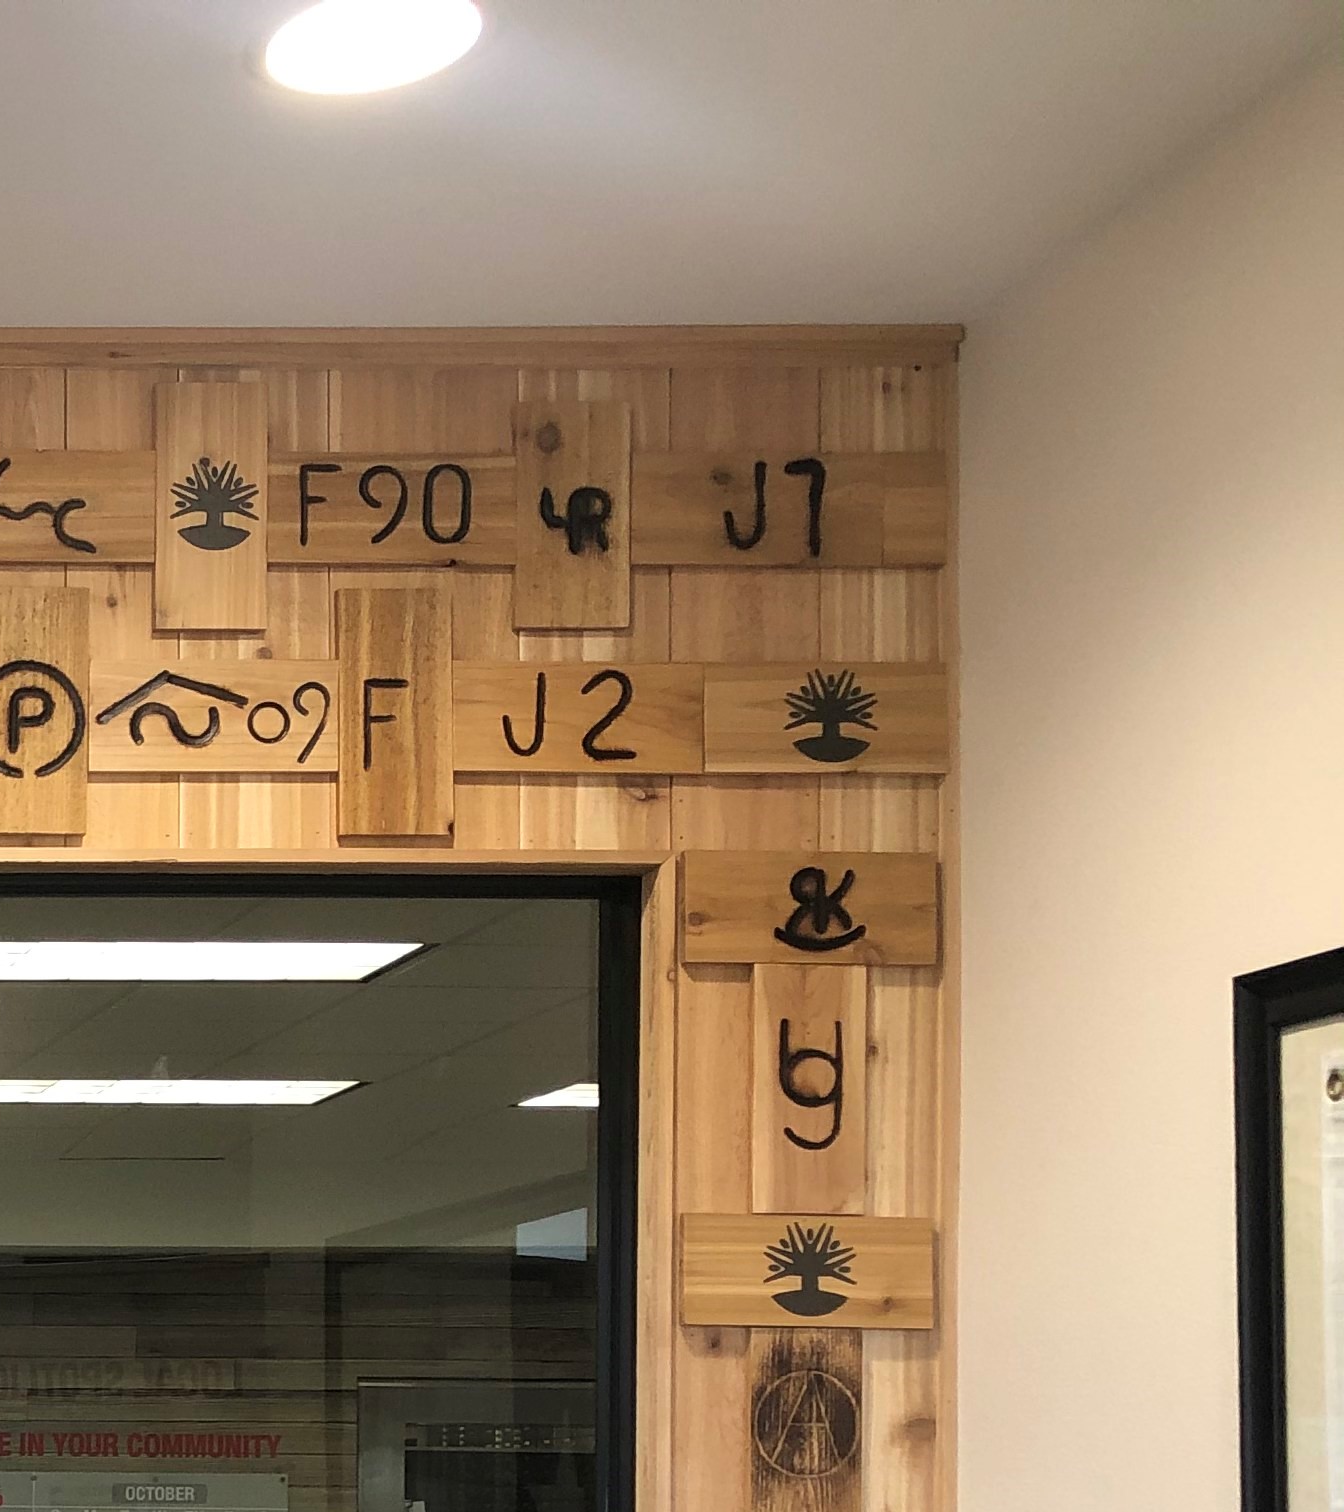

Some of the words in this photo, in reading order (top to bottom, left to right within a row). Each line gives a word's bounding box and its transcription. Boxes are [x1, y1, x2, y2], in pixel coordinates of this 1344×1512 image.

[363, 677, 408, 770] F
[20, 1432, 45, 1457] IN
[53, 1433, 119, 1457] YOUR
[126, 1433, 282, 1458] COMMUNITY
[125, 1486, 196, 1501] OCTOBER
